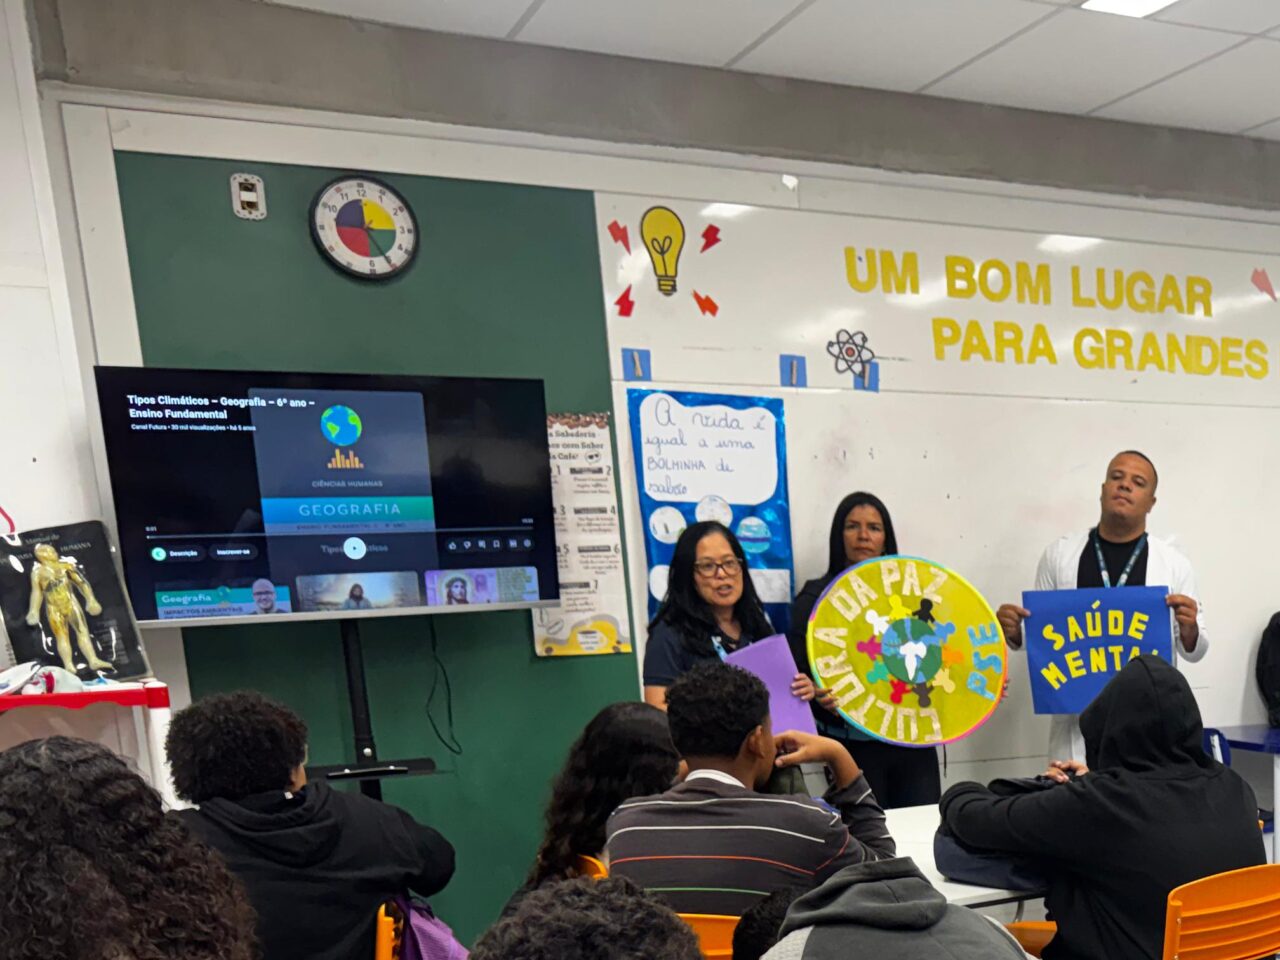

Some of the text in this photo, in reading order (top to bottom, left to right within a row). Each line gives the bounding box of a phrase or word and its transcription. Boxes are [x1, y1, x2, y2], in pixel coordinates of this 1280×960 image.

[844, 246, 1213, 318] UM BOM LUGAR
[931, 316, 1058, 366] PARA
[1073, 327, 1269, 380] GRANDES
[126, 394, 156, 406] Tipos
[157, 395, 210, 406] Climáticos
[220, 396, 266, 408] Geografia
[129, 408, 228, 419] Ensino Fundamental
[655, 398, 676, 426] A
[644, 428, 755, 456] igual a uma
[716, 459, 734, 472] de
[312, 479, 346, 488] CIÊNCIAS
[648, 475, 688, 495] sabão
[299, 503, 401, 516] GEOGRAFIA
[162, 594, 212, 604] Geografia
[1042, 600, 1149, 651] SAÚDE
[814, 560, 948, 742] CULTURA DA PAZ
[966, 622, 1003, 700] PSE
[1040, 645, 1158, 690] MENTA
